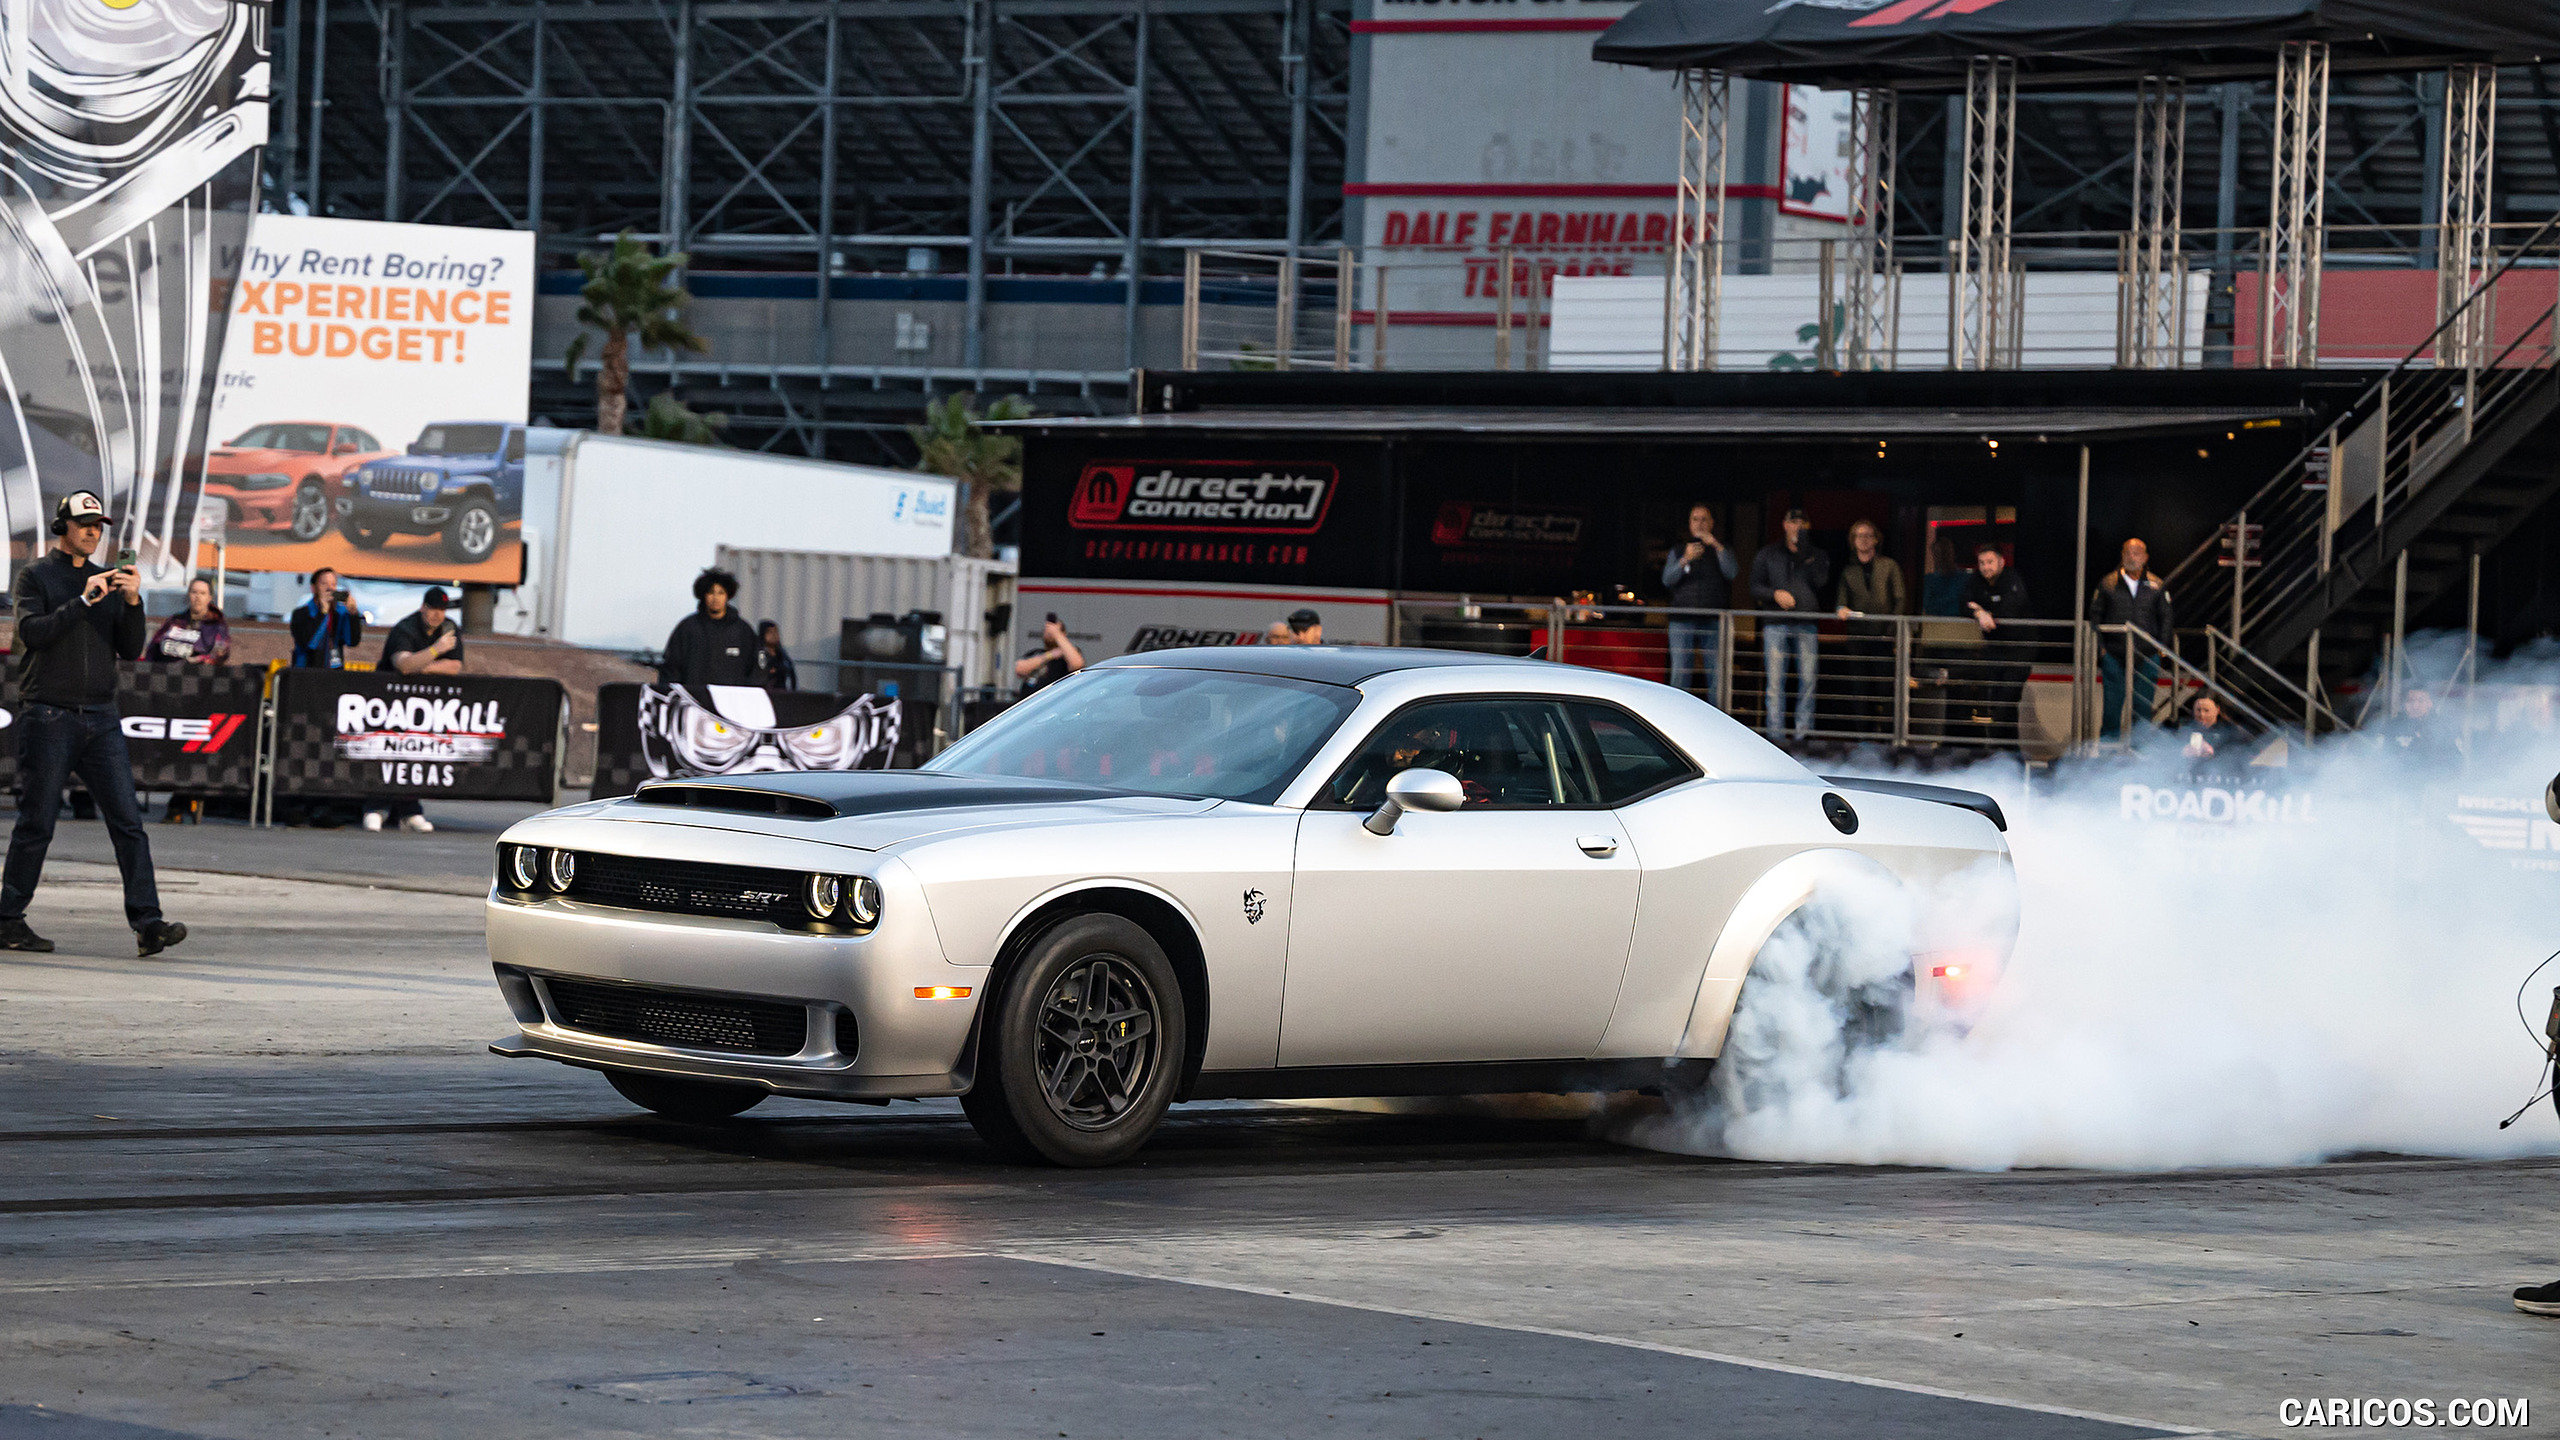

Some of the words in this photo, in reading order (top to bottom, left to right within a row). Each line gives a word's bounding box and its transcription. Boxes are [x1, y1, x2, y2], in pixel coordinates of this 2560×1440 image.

[1382, 211, 1478, 251] DALE
[299, 249, 374, 277] Rent
[382, 252, 505, 288] Boring?
[253, 321, 466, 364] BUDGET!
[1135, 470, 1278, 499] direct
[1128, 498, 1316, 520] connection
[381, 762, 454, 787] VEGAS
[2457, 795, 2546, 814] MICKE
[739, 890, 789, 904] SRT
